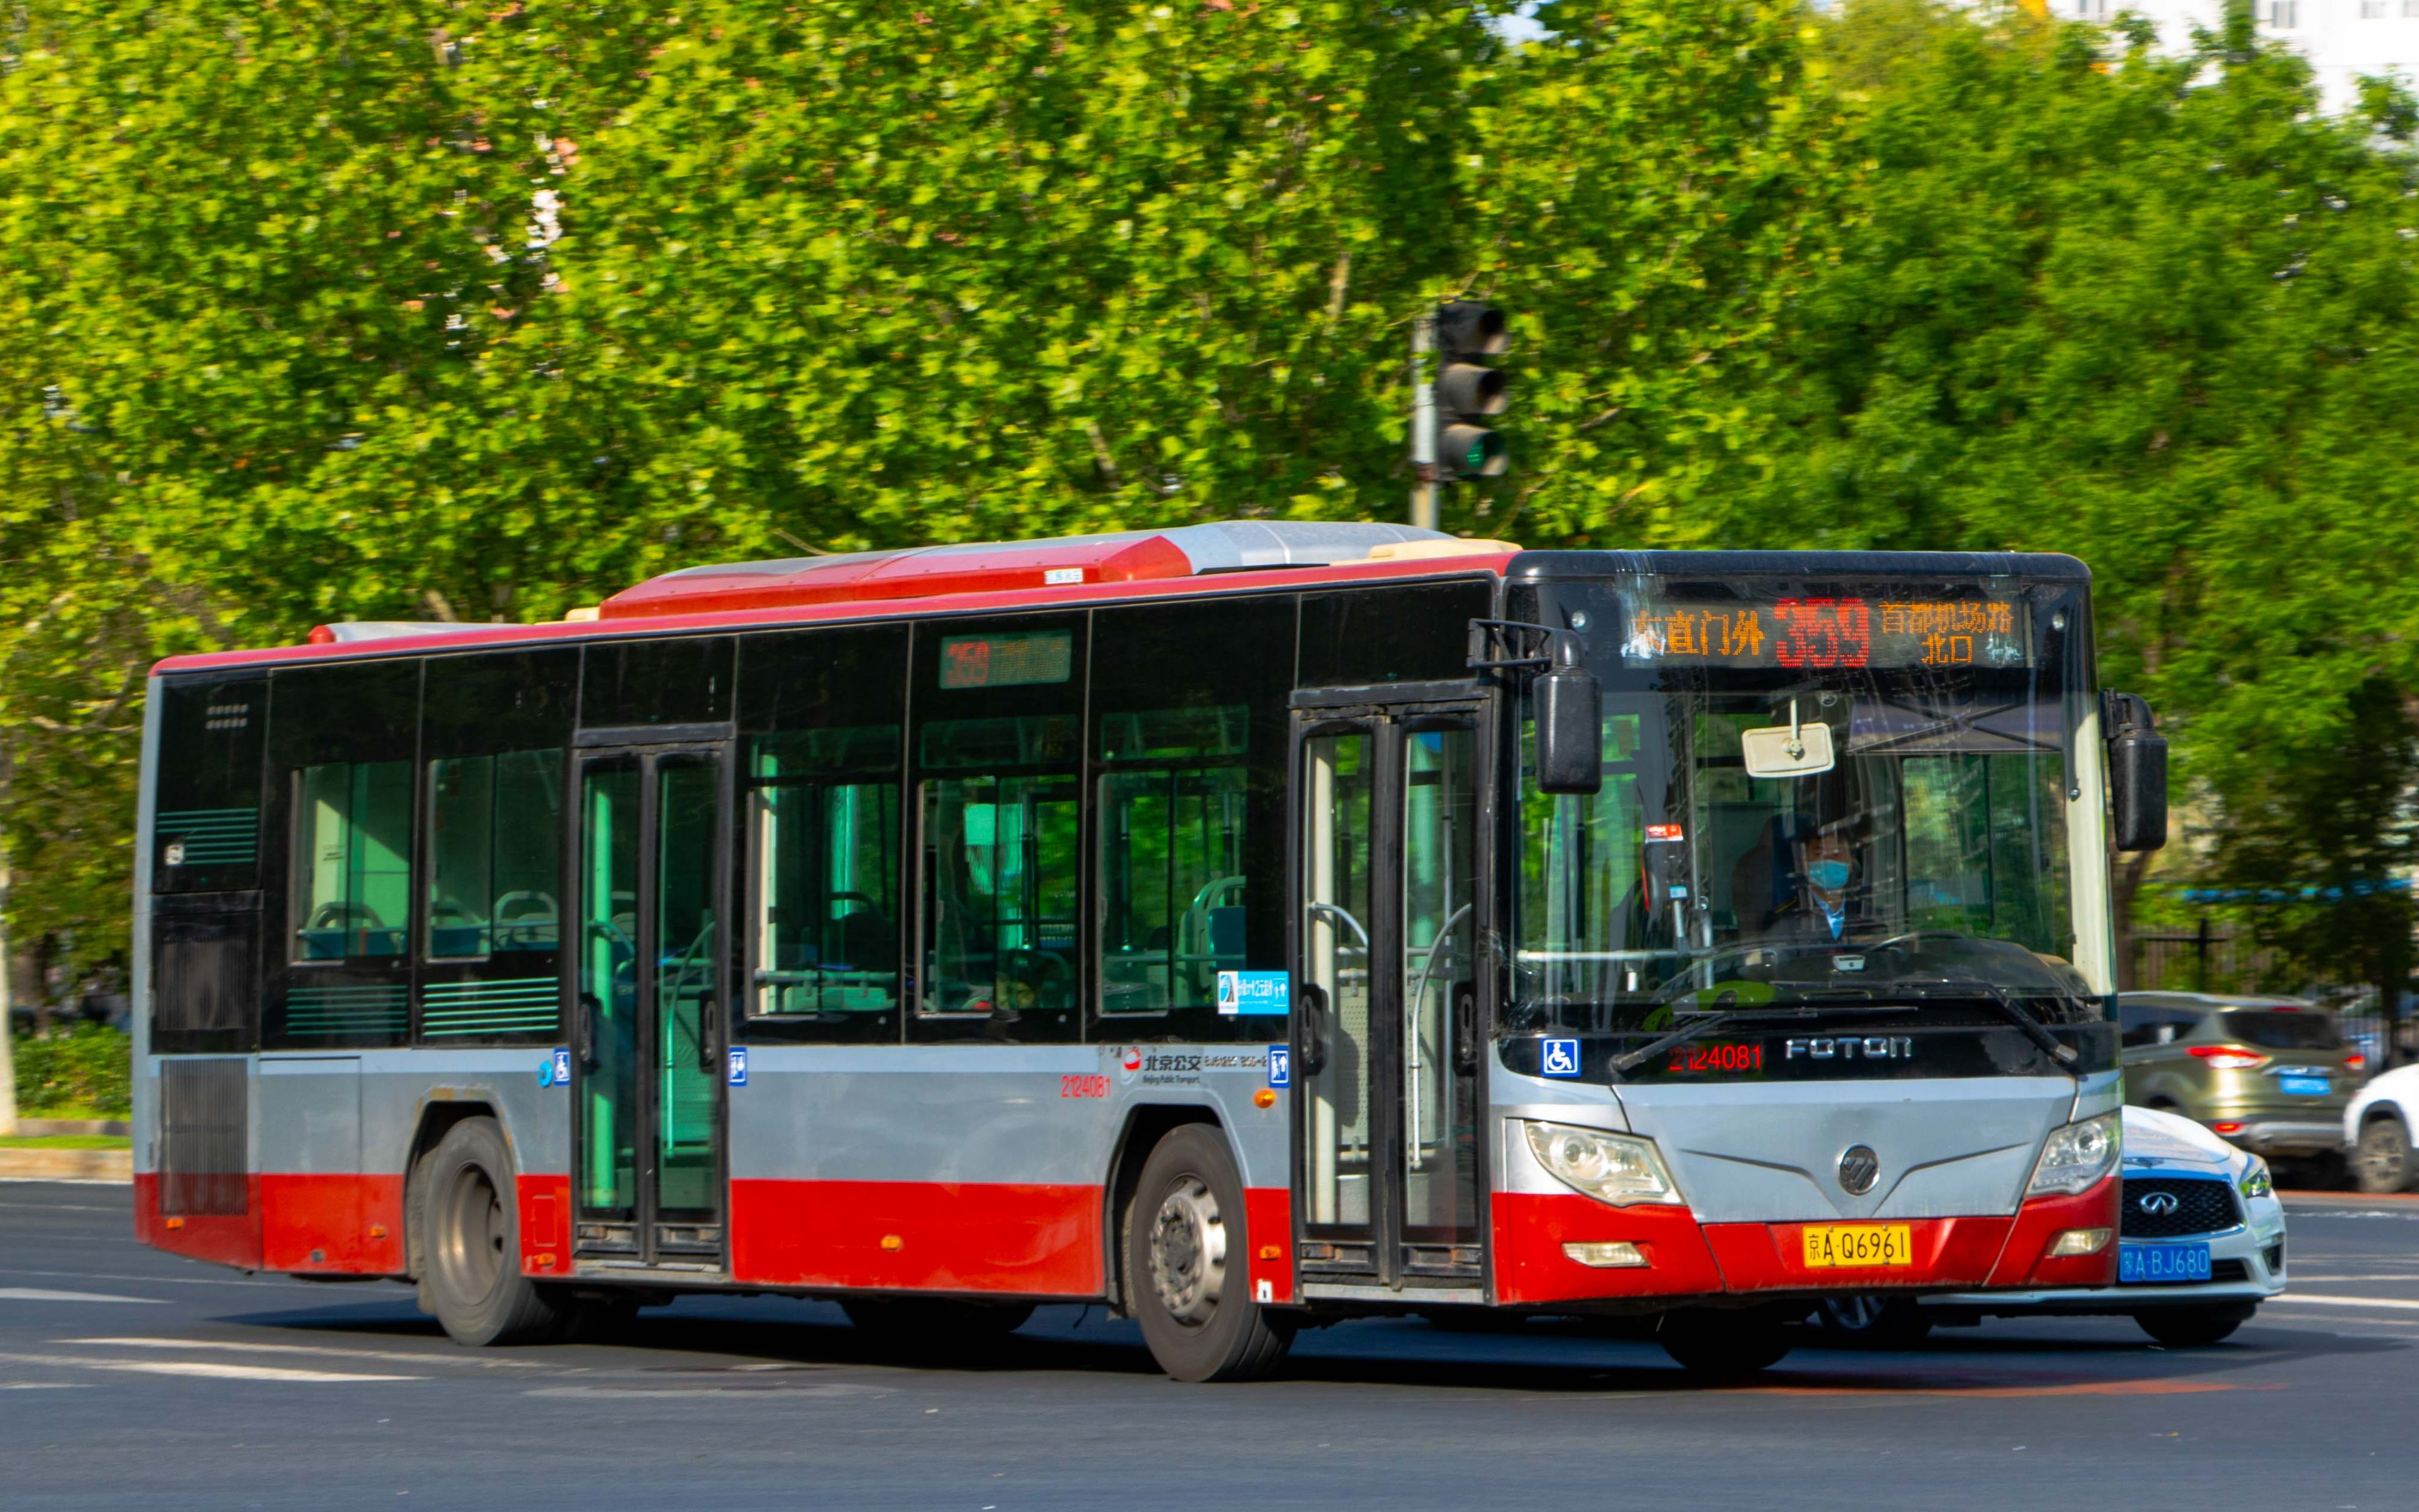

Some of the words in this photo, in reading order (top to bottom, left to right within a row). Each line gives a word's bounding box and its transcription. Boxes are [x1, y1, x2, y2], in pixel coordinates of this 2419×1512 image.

[1878, 601, 2015, 634] 首都机场路
[1773, 598, 1870, 668] 359
[1921, 632, 1973, 665] 北口
[1668, 1044, 1762, 1072] 2124081
[1785, 1037, 1912, 1060] FOTON
[1144, 1055, 1201, 1072] 北京公交
[1060, 1075, 1111, 1098] 2124081
